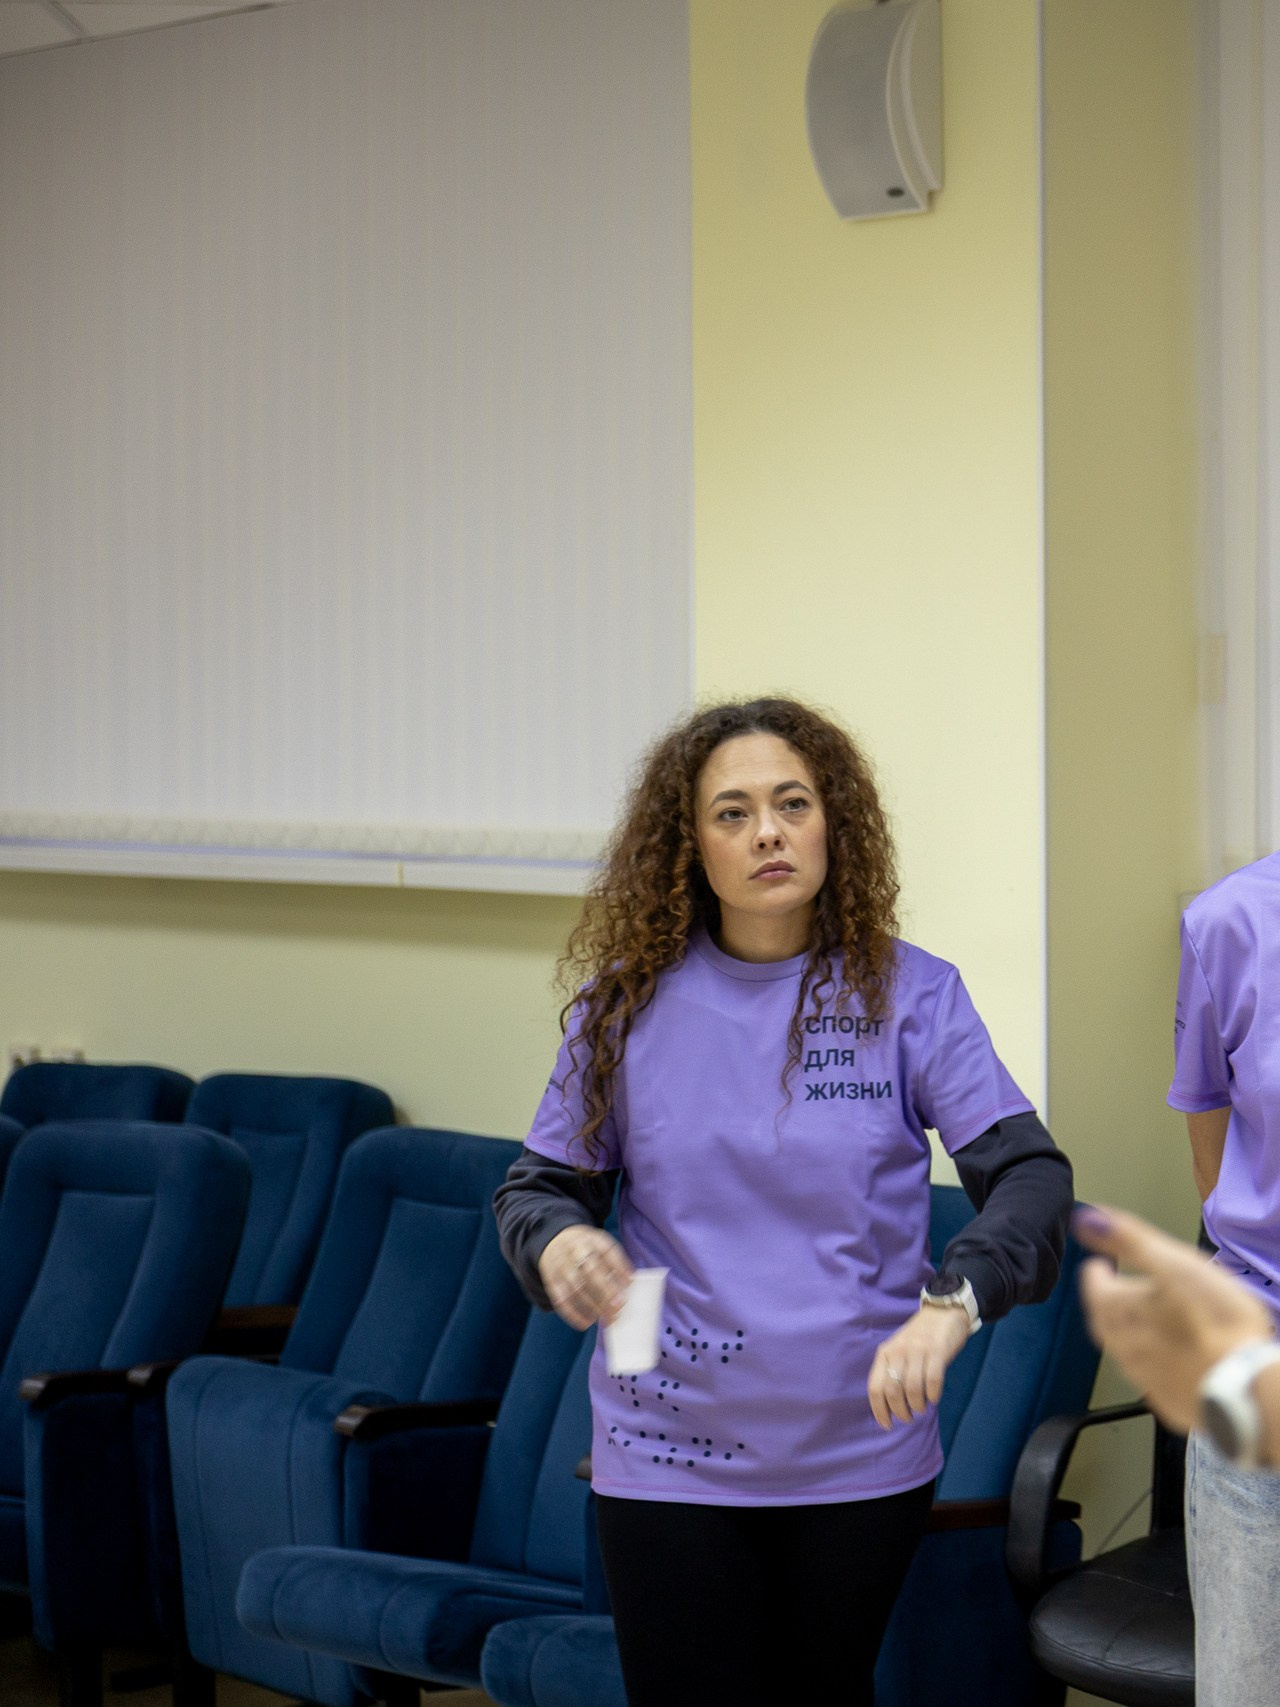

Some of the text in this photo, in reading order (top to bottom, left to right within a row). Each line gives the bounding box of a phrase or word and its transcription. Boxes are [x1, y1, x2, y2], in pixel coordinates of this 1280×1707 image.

[805, 1015, 884, 1039] спорт
[804, 1048, 855, 1073] для
[804, 1080, 893, 1102] жизни
